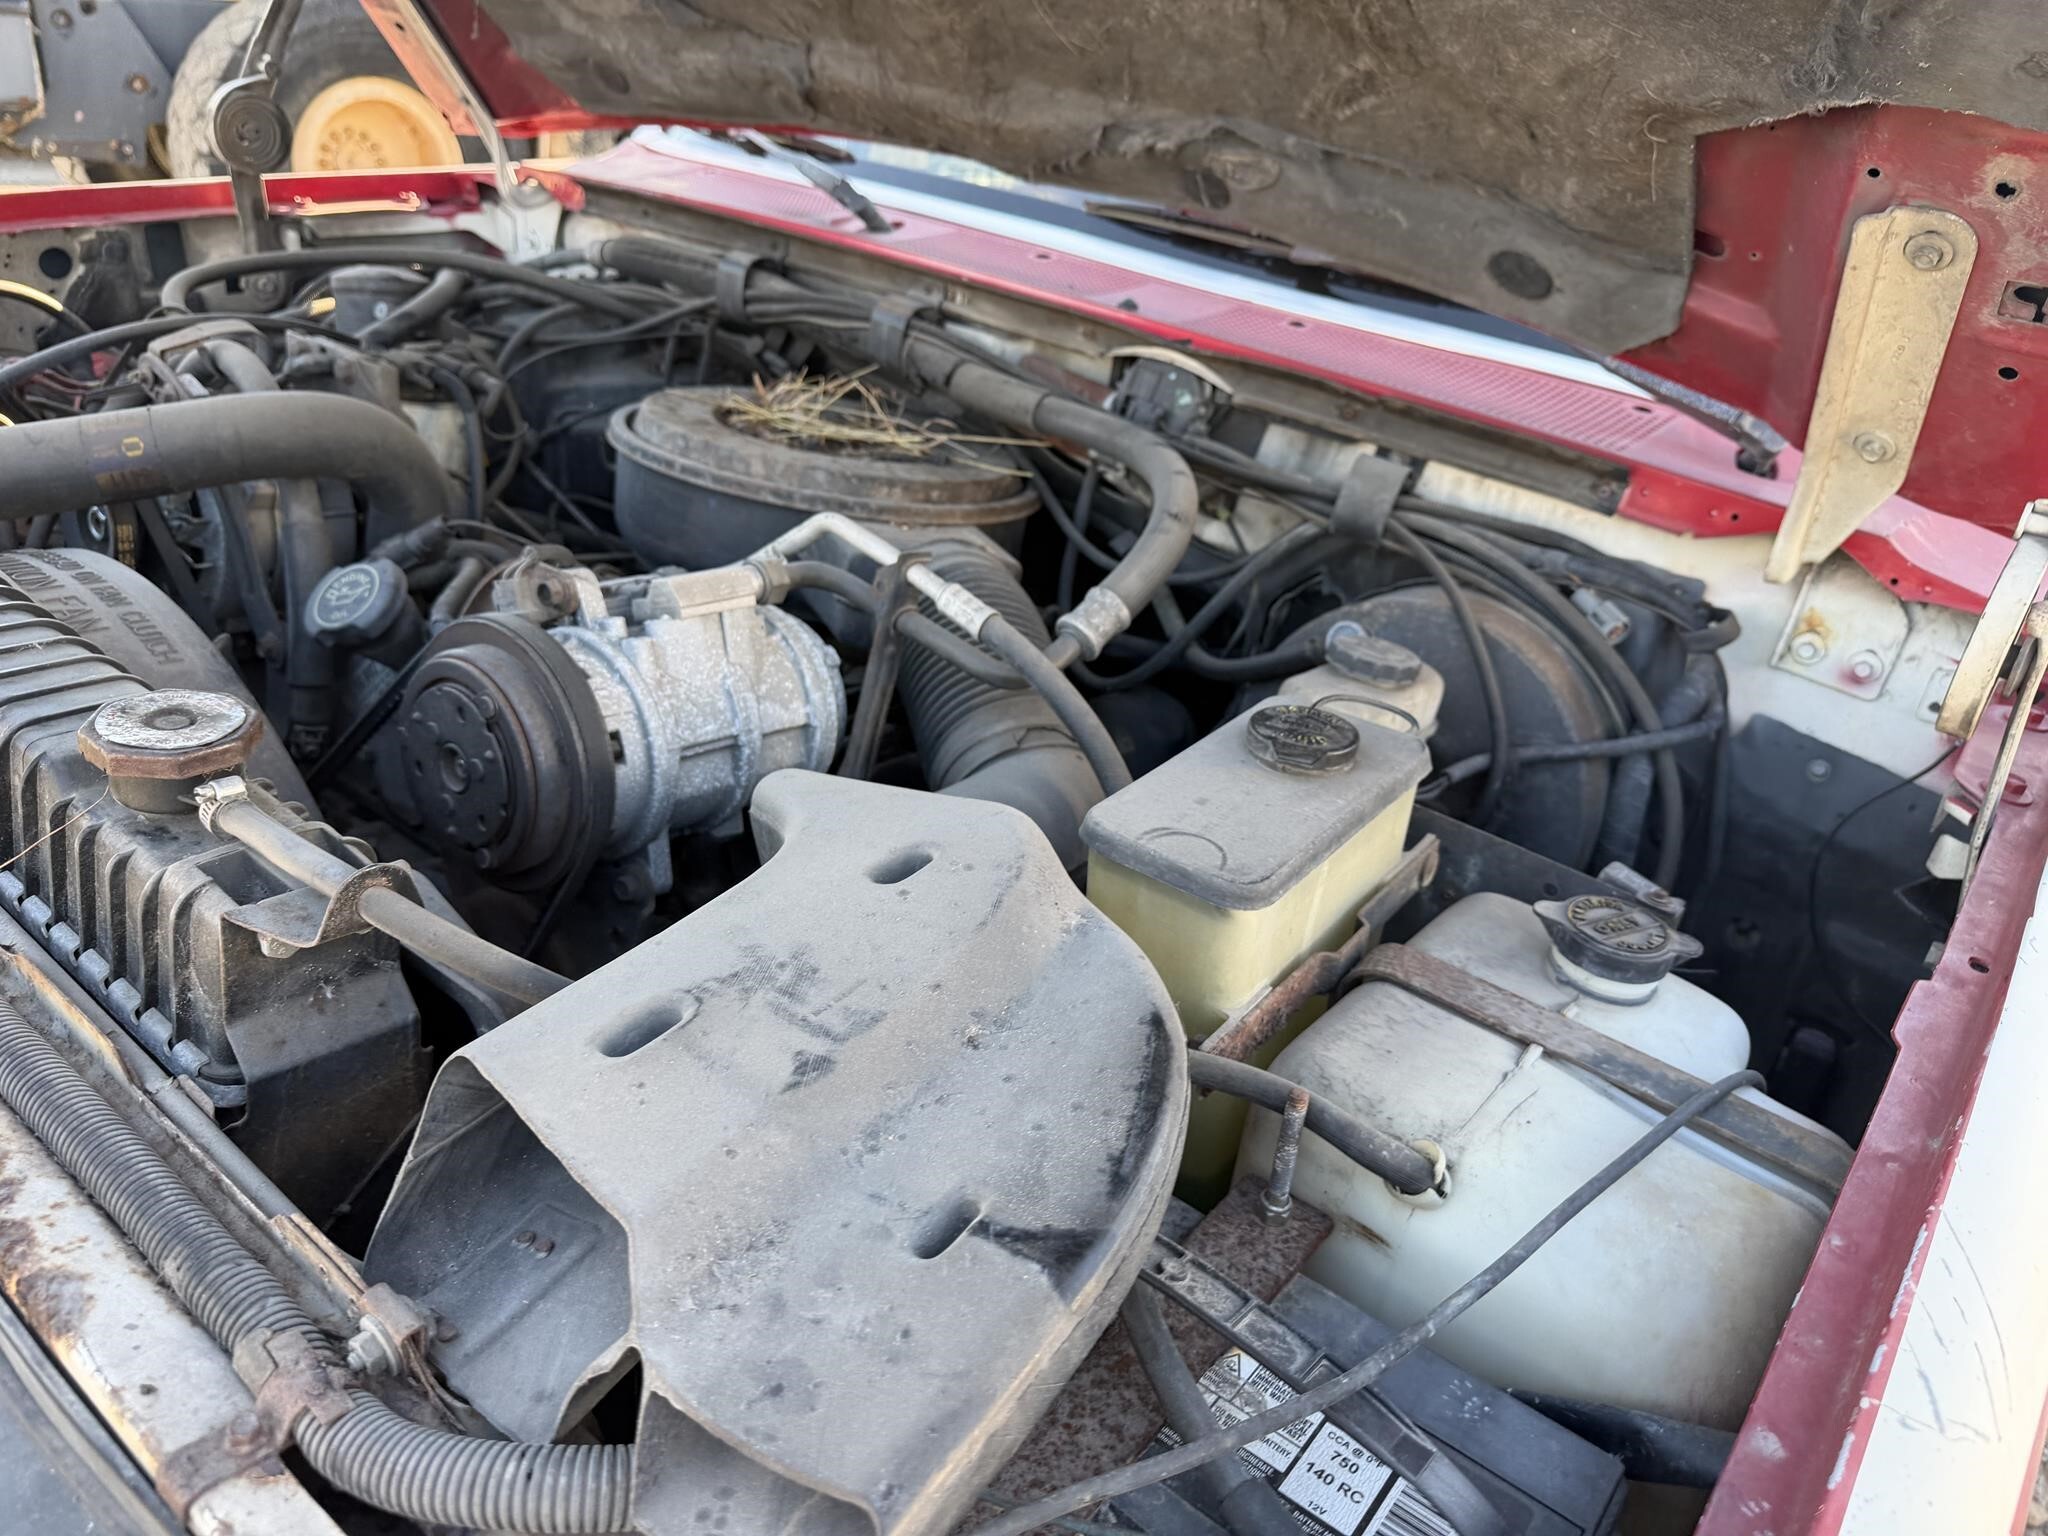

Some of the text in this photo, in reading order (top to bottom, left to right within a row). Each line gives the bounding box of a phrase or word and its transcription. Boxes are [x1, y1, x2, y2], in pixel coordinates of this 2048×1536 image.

[1327, 1431, 1350, 1448] CCA
[1352, 1447, 1364, 1459] @
[1330, 1451, 1360, 1474] 750
[1306, 1462, 1365, 1504] 140 RC
[1307, 1501, 1328, 1515] 12V
